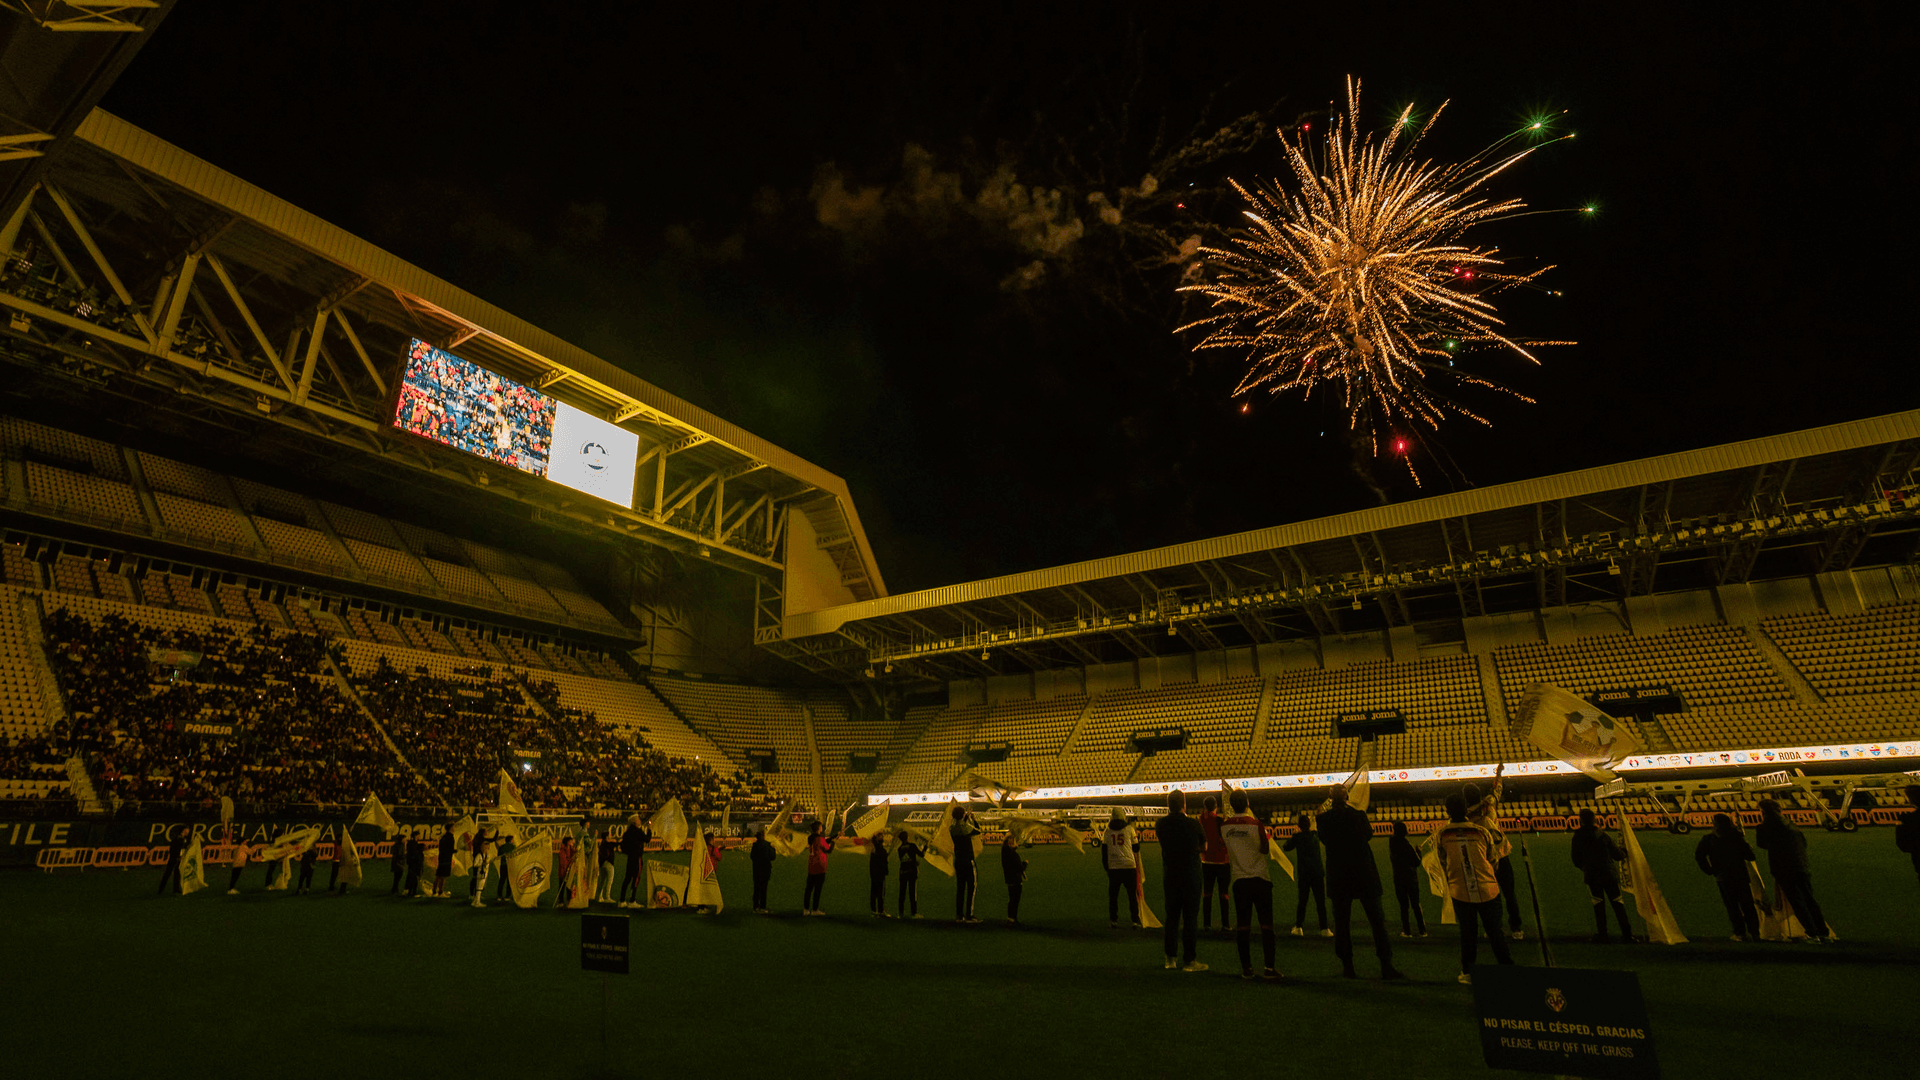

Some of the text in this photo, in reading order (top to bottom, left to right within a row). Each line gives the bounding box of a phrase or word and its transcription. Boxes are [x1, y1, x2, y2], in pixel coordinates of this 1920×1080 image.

[184, 723, 233, 735] PAMESA
[1778, 751, 1801, 761] RODA
[517, 823, 574, 839] RGENTA
[1111, 834, 1125, 846] 15
[1484, 1017, 1645, 1039] NO PISAR EL CÉSPED, GRACIAS
[1538, 1039, 1560, 1051] KEEP
[1563, 1042, 1578, 1054] OFF
[1582, 1043, 1600, 1056] THE
[1602, 1045, 1634, 1058] GRASS
